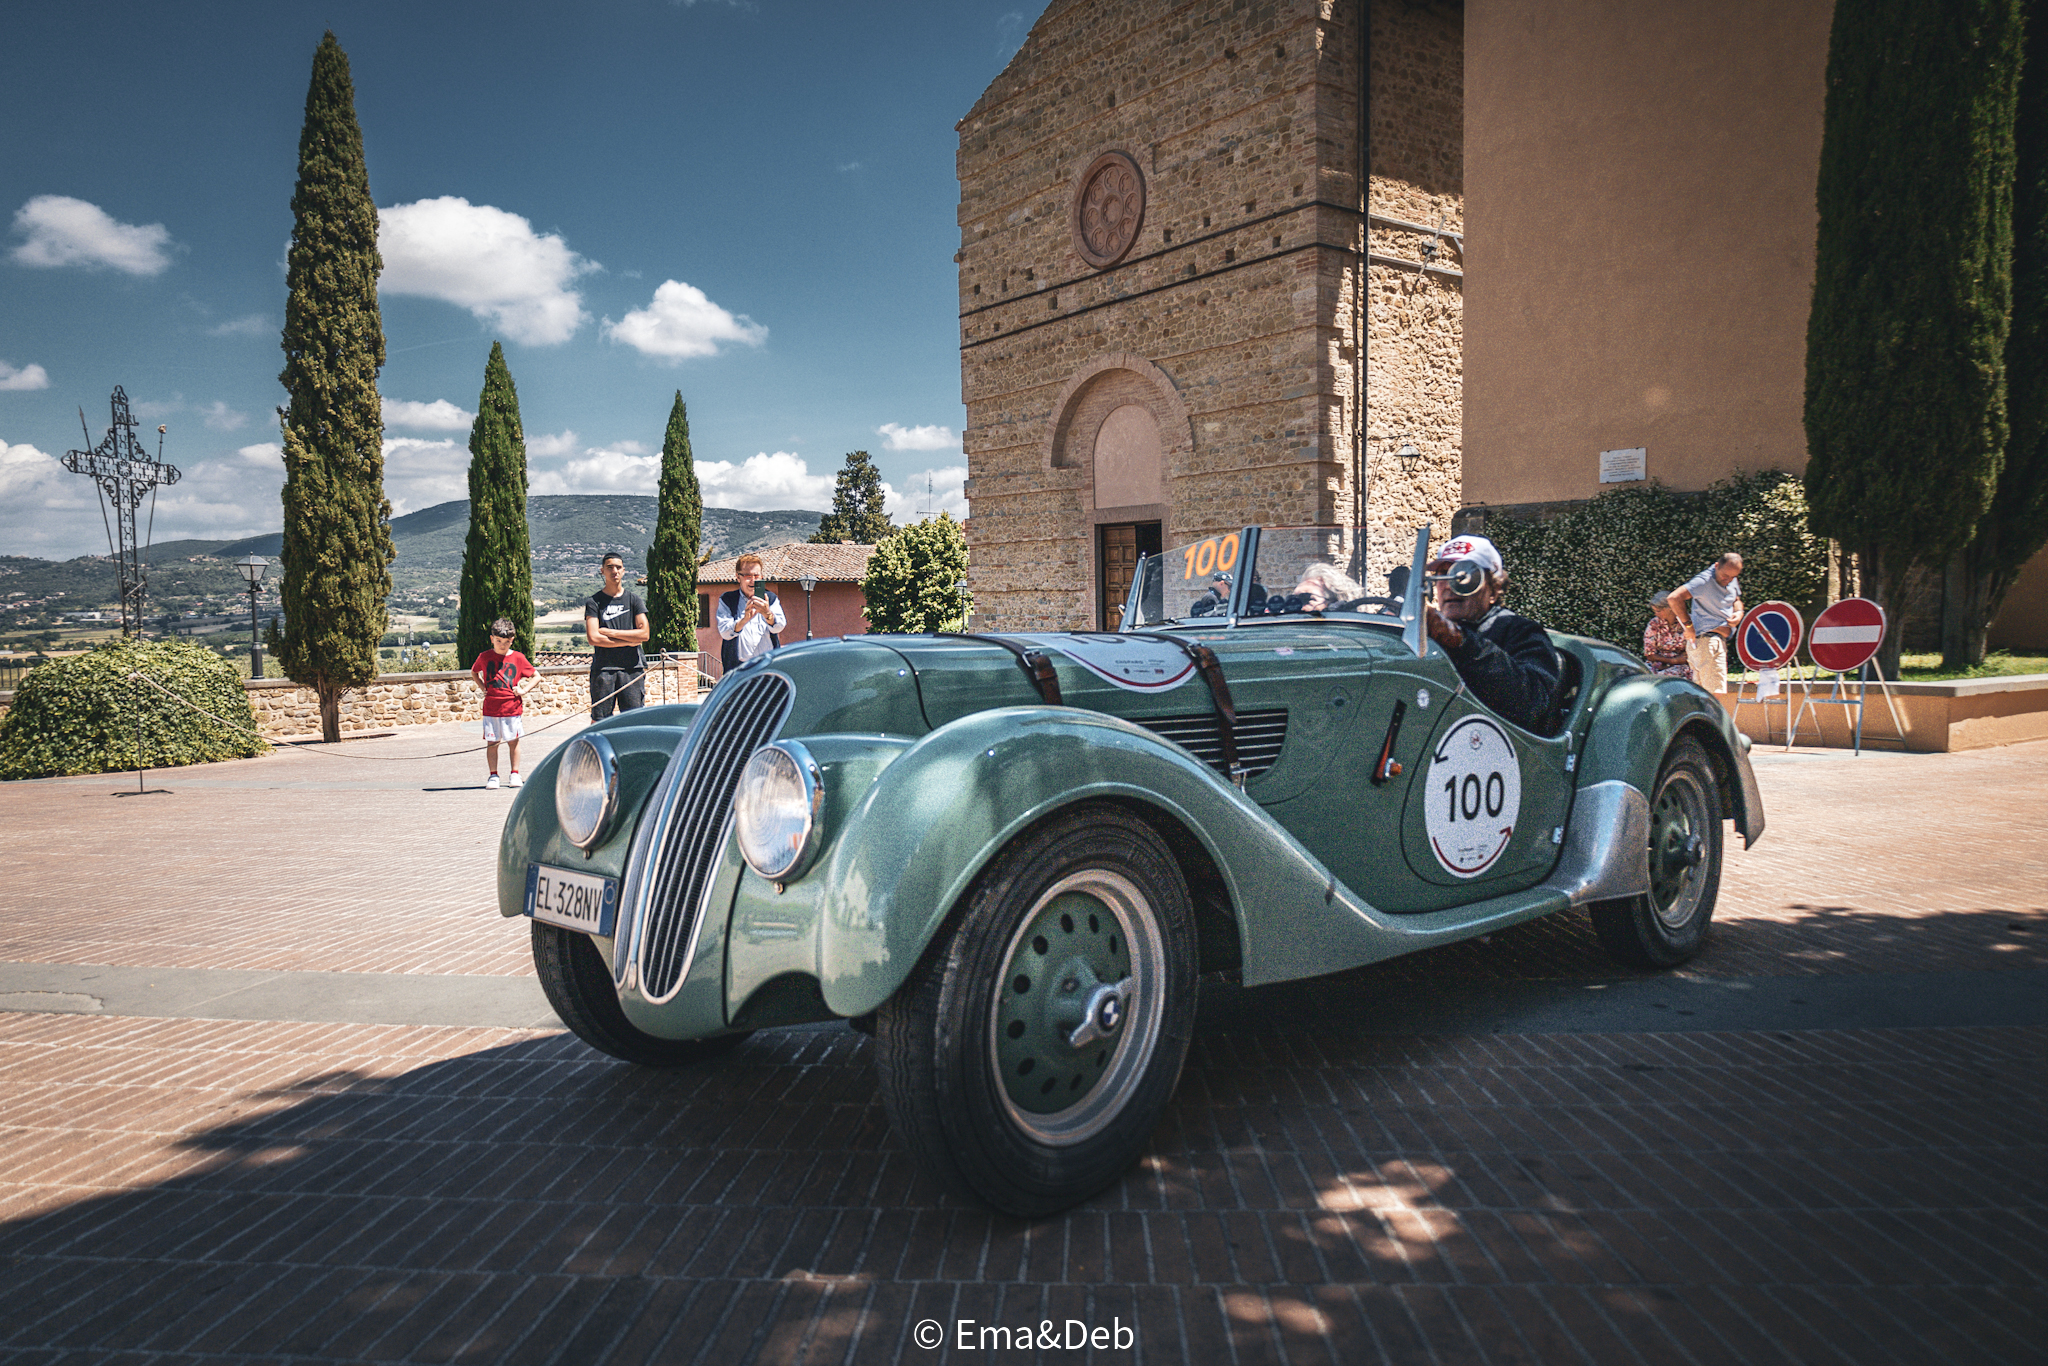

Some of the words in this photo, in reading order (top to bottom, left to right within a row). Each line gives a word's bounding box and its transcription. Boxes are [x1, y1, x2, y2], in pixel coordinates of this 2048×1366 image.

[1184, 533, 1240, 580] 100
[606, 604, 625, 614] NIKE
[1444, 771, 1505, 823] 100
[536, 876, 552, 911] EL
[556, 881, 603, 922] 328NV
